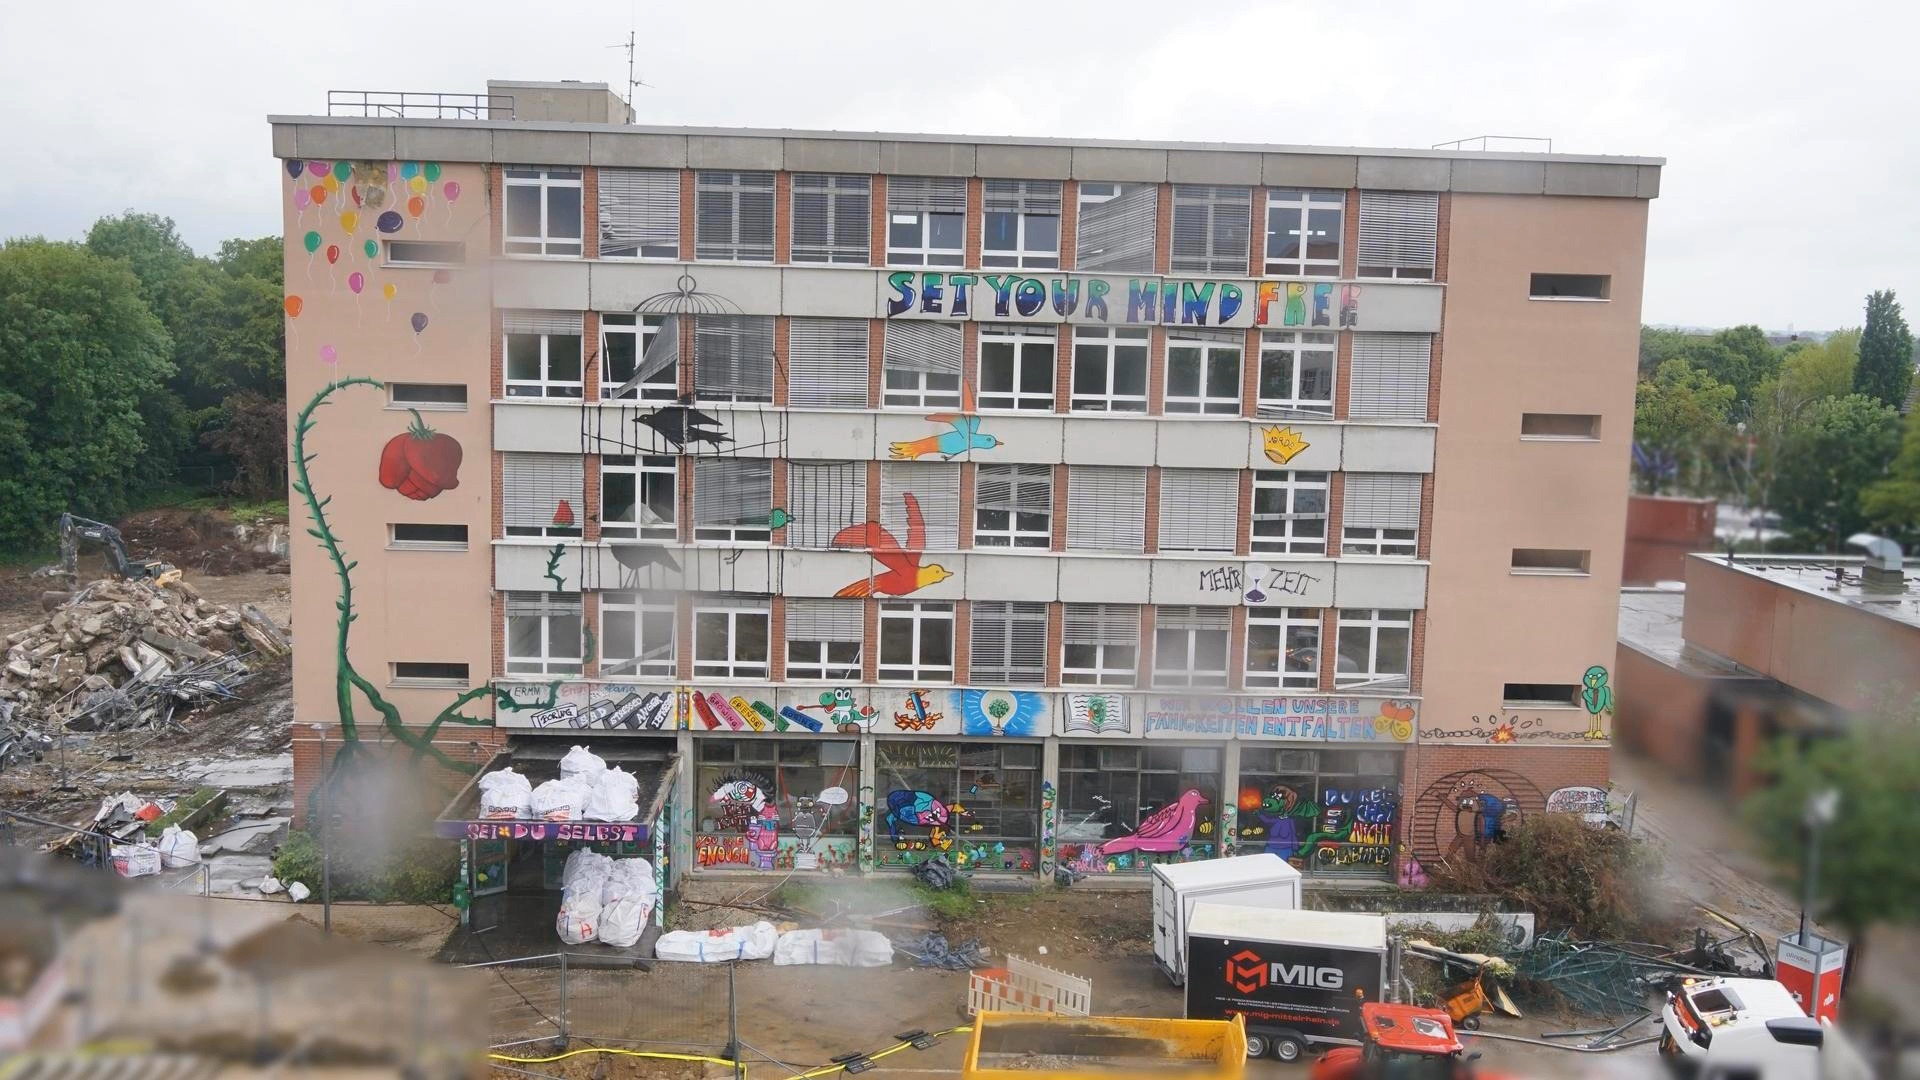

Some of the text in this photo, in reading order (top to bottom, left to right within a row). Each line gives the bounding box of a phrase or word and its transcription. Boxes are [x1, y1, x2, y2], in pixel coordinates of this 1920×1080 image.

[887, 271, 1362, 329] SET YOUR MIND FREE
[1199, 566, 1321, 596] MEHR ZEIT
[610, 697, 642, 725] STRESSED
[636, 696, 663, 725] ANGER
[710, 696, 737, 727] GROWING
[732, 699, 760, 727] FRIENDS
[1200, 695, 1287, 715] OLLEN
[1292, 699, 1360, 714] UNSERE
[1262, 715, 1376, 740] ENTFALTEN
[467, 824, 638, 841] SEI DU SELBST
[696, 836, 718, 849] YOU
[697, 846, 749, 866] ENOUGH
[1271, 962, 1344, 989] MIG
